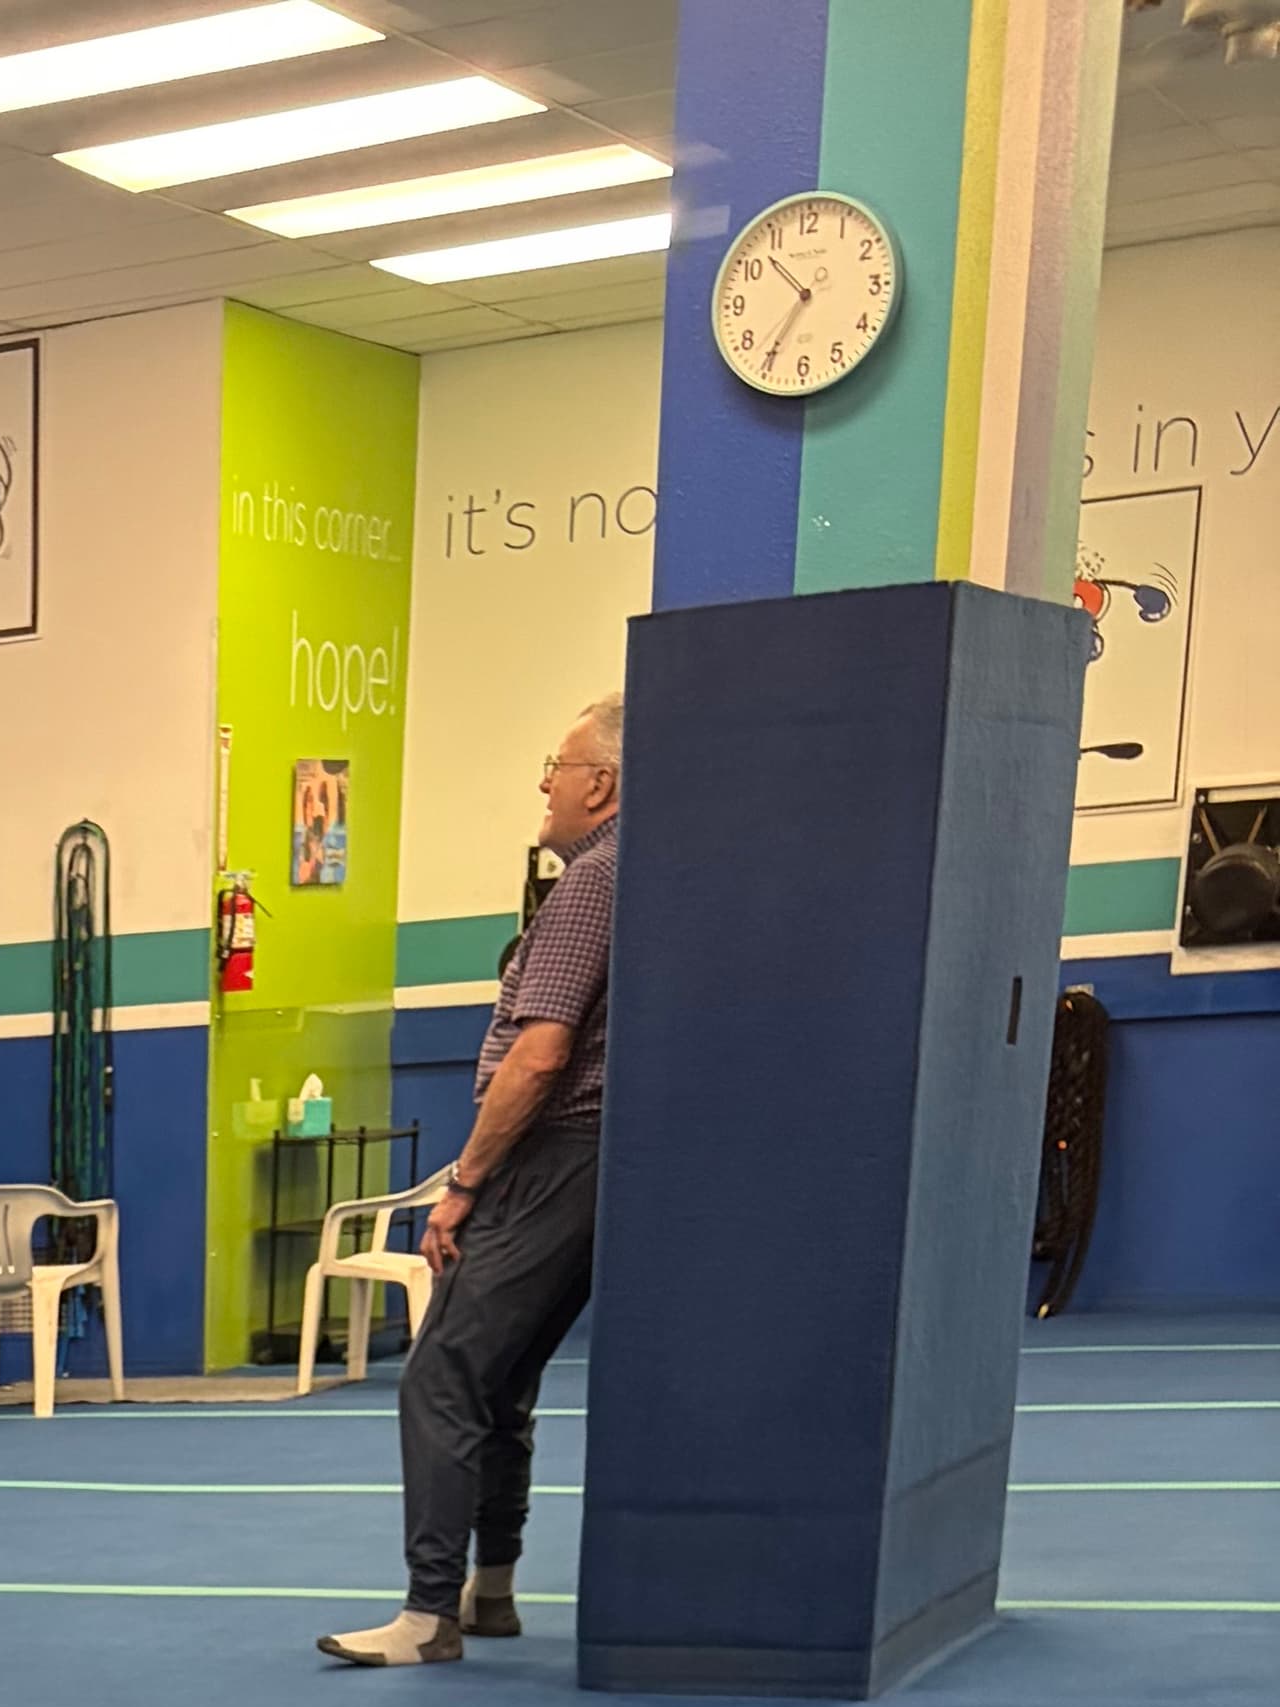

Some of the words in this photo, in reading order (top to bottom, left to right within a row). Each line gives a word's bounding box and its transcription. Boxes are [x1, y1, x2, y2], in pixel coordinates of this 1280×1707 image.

[799, 211, 819, 236] 12
[839, 215, 845, 240] 1
[770, 228, 783, 250] 11
[859, 239, 873, 262] 2
[744, 258, 763, 282] 10
[868, 273, 882, 296] 3
[732, 295, 745, 316] 9
[855, 312, 868, 334] 4
[741, 329, 754, 351] 8
[830, 341, 844, 364] 5
[796, 355, 810, 378] 6
[1132, 403, 1198, 474] in
[232, 473, 255, 537] in
[262, 479, 308, 547] this
[444, 488, 537, 559] it's
[290, 608, 400, 732] hope!
